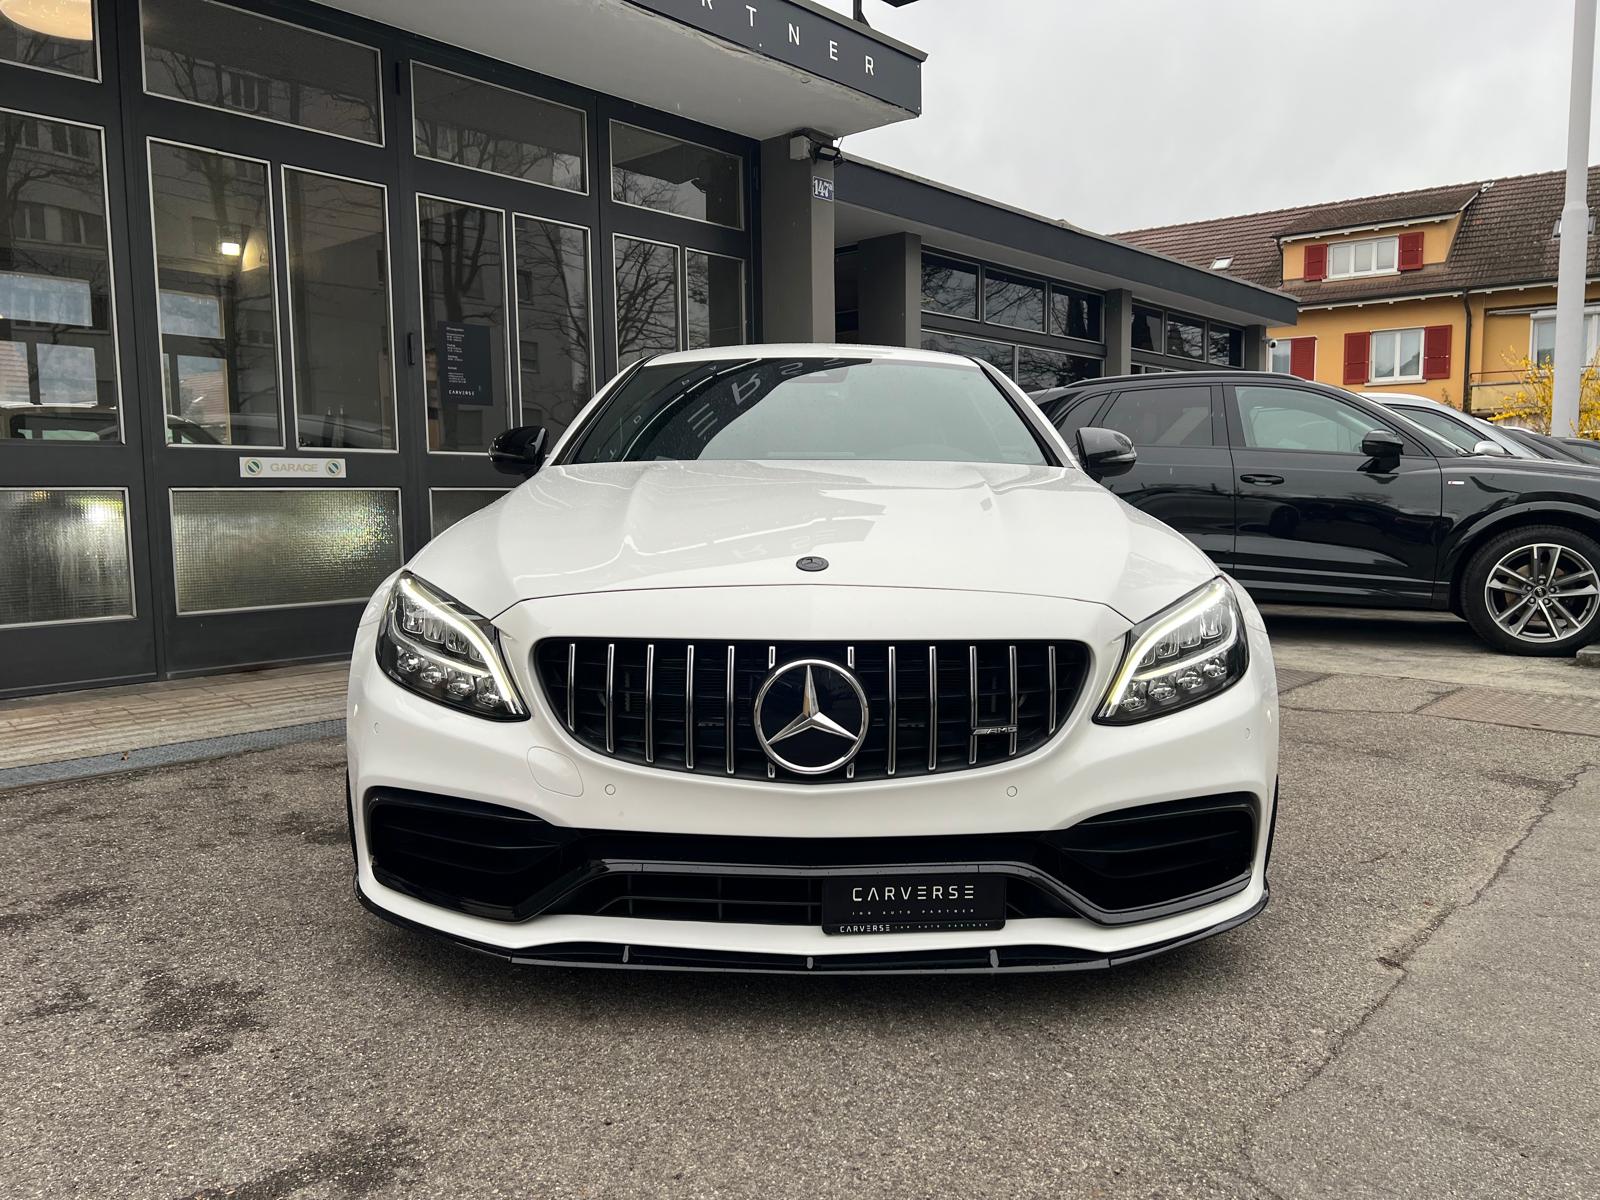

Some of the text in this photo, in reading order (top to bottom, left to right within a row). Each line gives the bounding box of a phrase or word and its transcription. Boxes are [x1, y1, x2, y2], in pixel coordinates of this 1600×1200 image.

[270, 463, 318, 472] GARAGE
[852, 885, 974, 901] CARVERSE
[839, 924, 891, 933] CARVERSE
